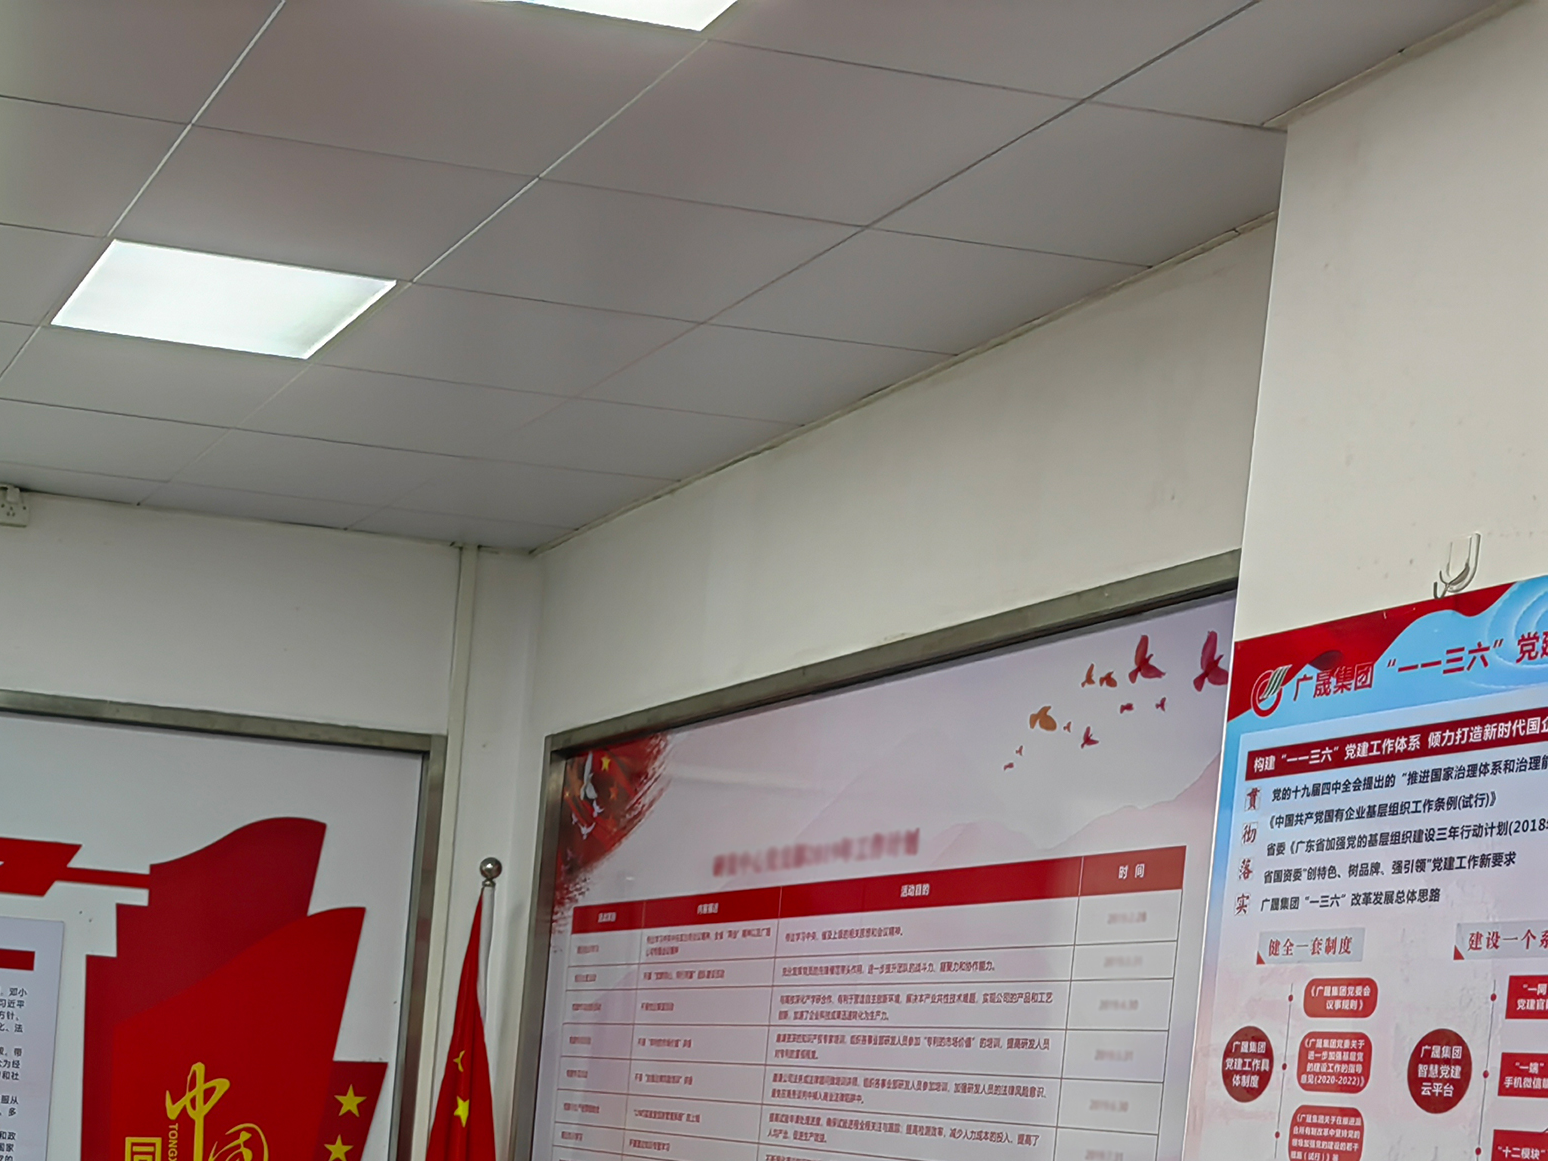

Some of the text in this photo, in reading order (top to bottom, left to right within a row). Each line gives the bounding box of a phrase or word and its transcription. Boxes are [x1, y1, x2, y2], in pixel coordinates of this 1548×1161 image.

[1267, 817, 1548, 857] 省委《广东省加强党的基层组织建设三年行动计划(2018
[1268, 936, 1352, 957] 健全一套制度
[1232, 1041, 1266, 1054] 广晟集团
[1420, 1046, 1462, 1060] 广晟集团
[1418, 1063, 1461, 1079] 智慧党建
[1232, 1074, 1259, 1088] 体制度
[1421, 1082, 1454, 1098] 云平台
